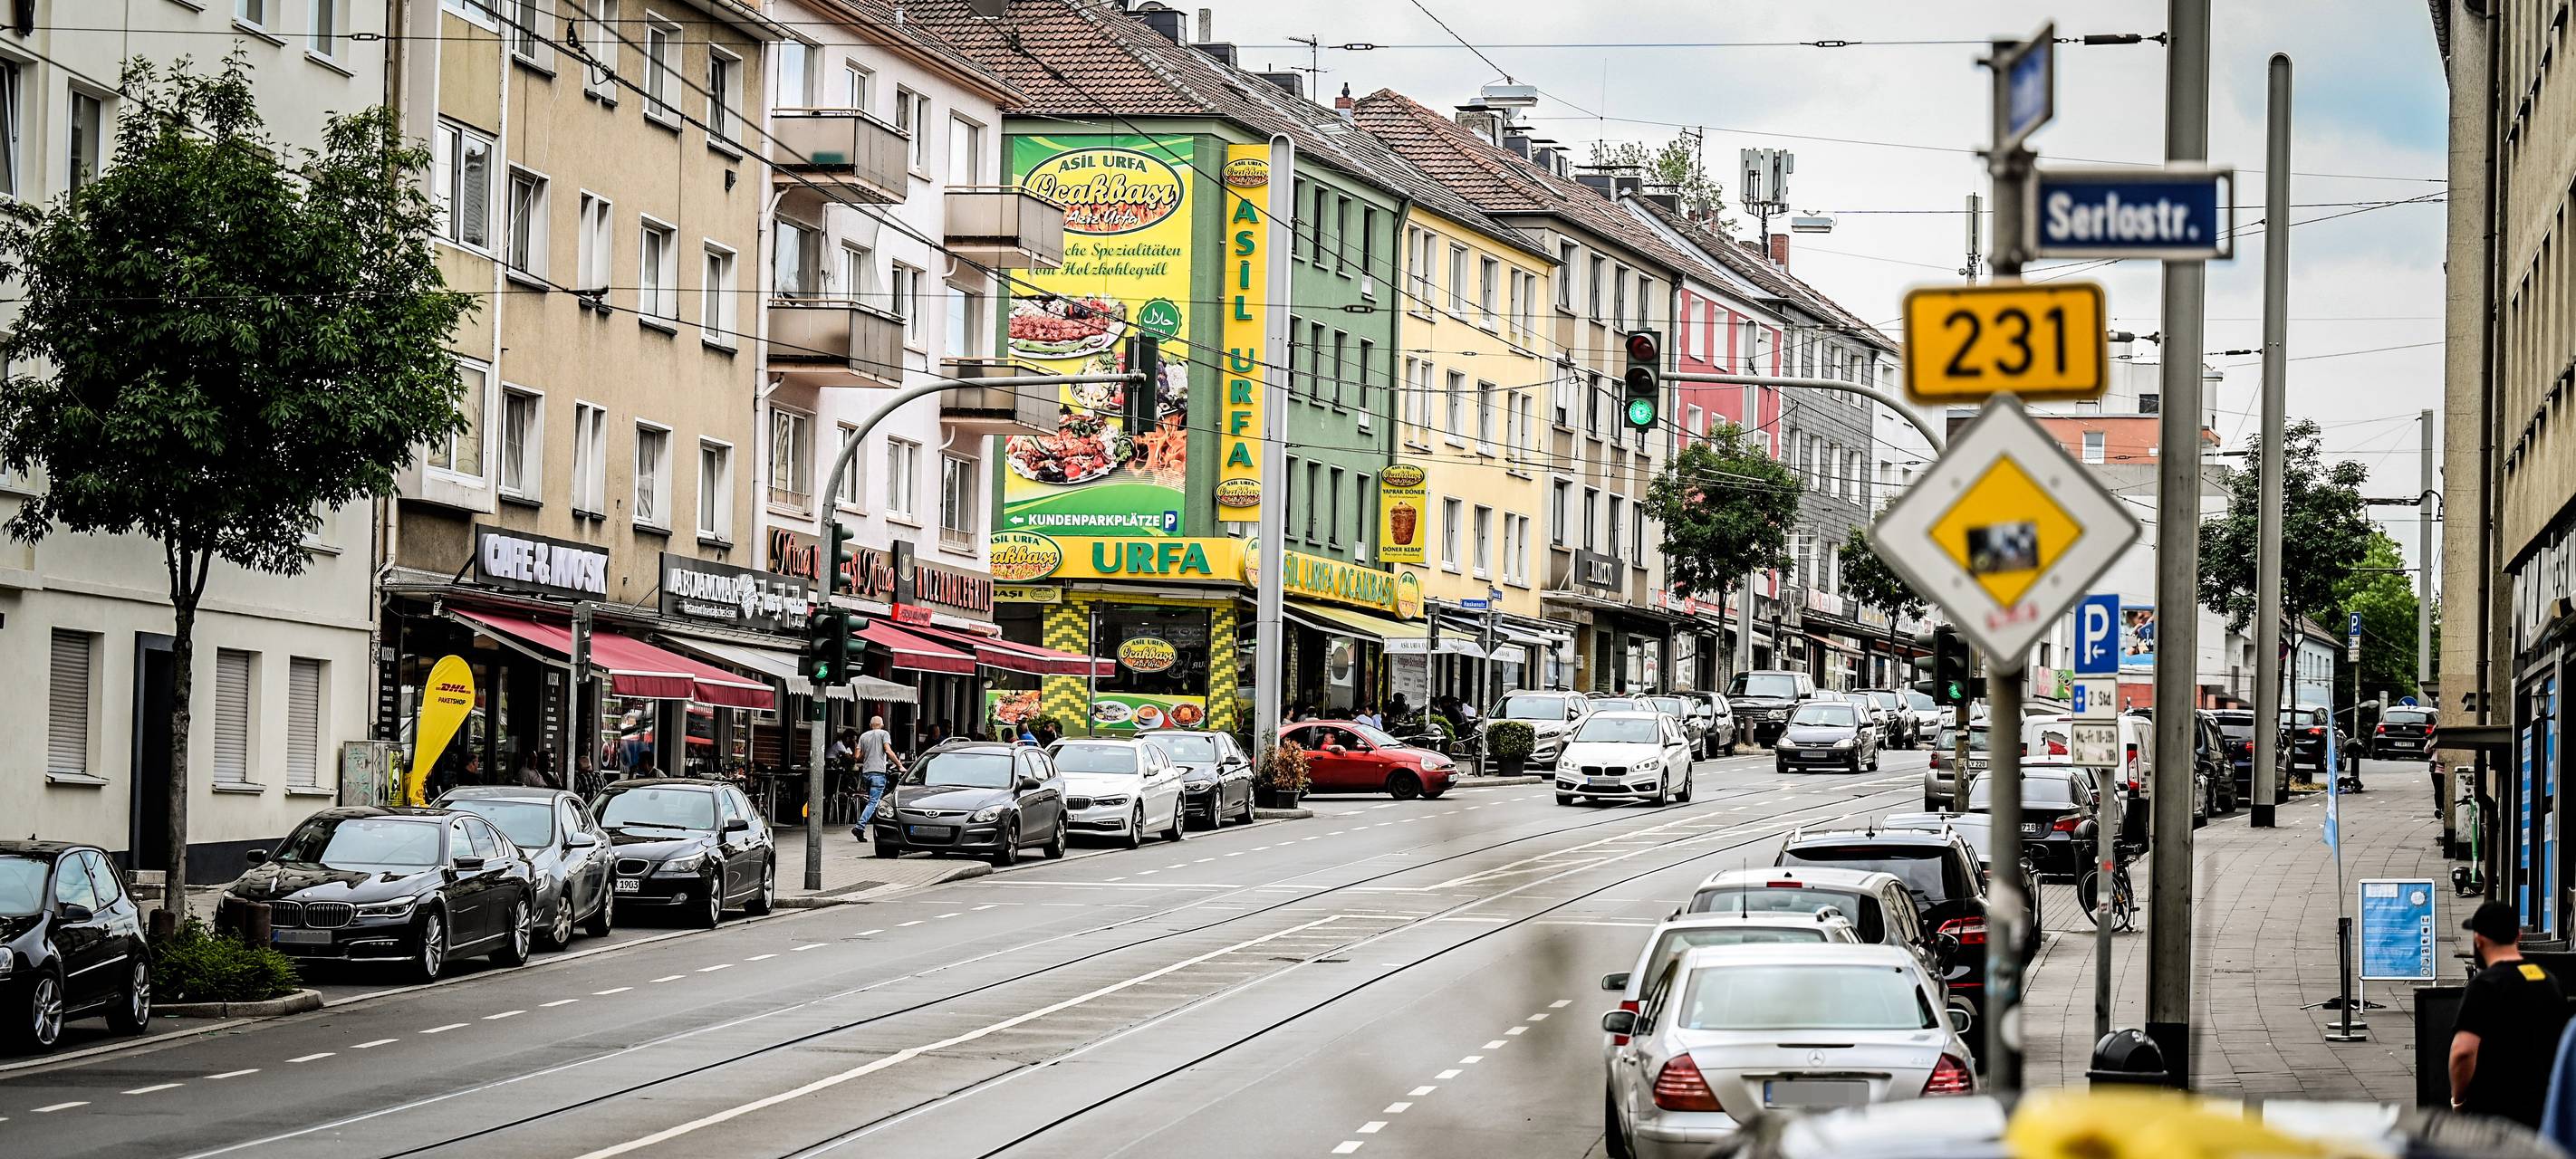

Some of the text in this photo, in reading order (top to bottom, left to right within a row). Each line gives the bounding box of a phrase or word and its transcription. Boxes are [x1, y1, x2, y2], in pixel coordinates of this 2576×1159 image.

[1102, 155, 1148, 173] URFA
[1065, 209, 1139, 225] Aziz Usta
[2047, 191, 2200, 241] Serlostr.
[1065, 243, 1181, 260] che Spezialitäten
[1061, 262, 1168, 279] Holzkohlegrill
[1943, 305, 2067, 378] 231
[1227, 348, 1254, 467] URFA
[1028, 513, 1160, 527] KUNDENPARKPLÄTZE
[991, 545, 1057, 568] akbaşı
[1091, 541, 1212, 574] URFA
[551, 546, 608, 594] KIOSK
[441, 683, 466, 694] DHL
[437, 696, 466, 705] PAKETSHOP
[2090, 691, 2112, 705] 2 Std.
[620, 880, 639, 889] 1903
